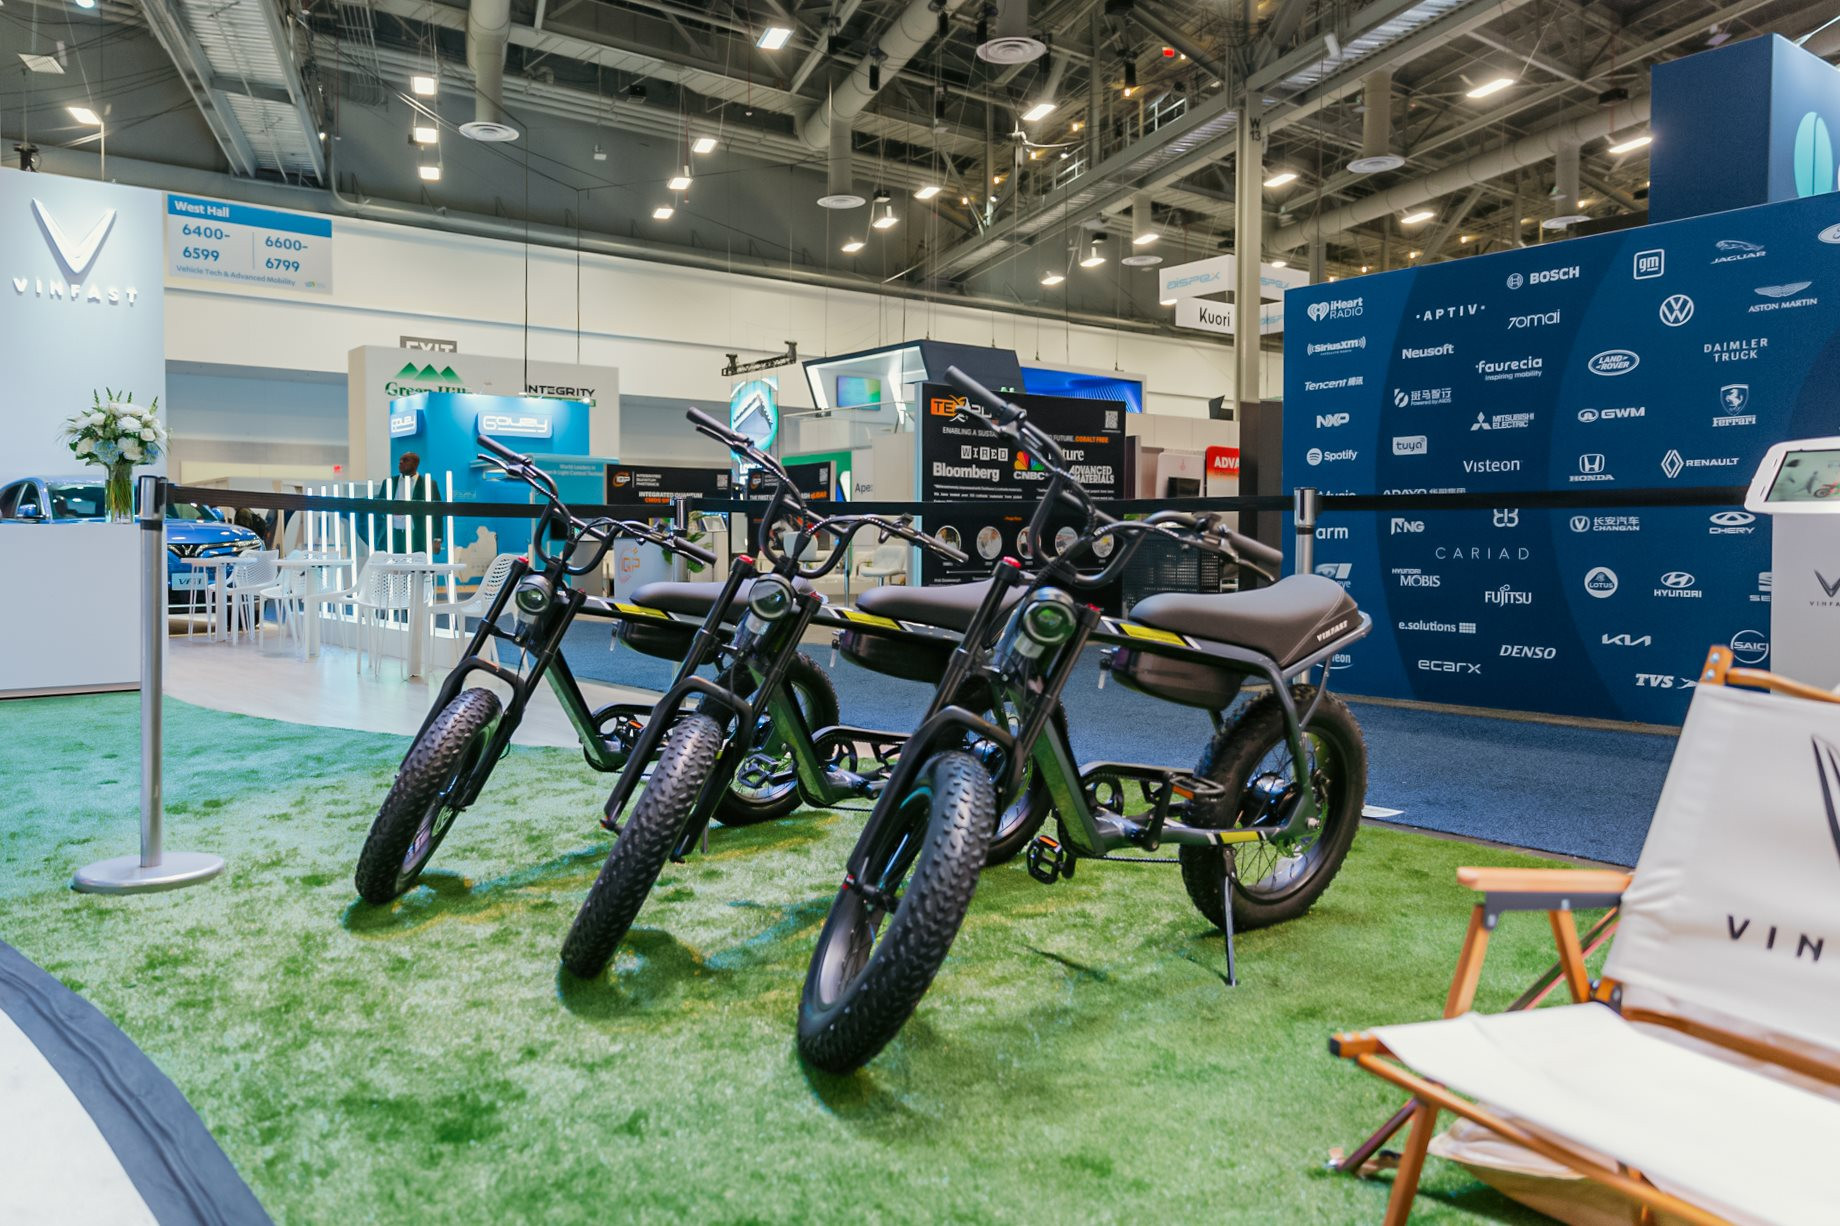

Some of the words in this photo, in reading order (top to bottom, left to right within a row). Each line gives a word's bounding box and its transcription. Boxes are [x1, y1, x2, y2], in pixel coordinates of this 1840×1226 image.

[174, 200, 205, 215] West
[207, 204, 230, 218] Hall
[182, 223, 230, 241] 6400-
[265, 235, 309, 252] 6600-
[183, 246, 219, 262] 6599
[1710, 251, 1767, 265] JAGUAR
[265, 257, 300, 273] 6799
[176, 264, 203, 275] Vehicle
[205, 269, 222, 277] Tech
[230, 272, 266, 283] Advanced
[266, 277, 296, 287] Mobility
[1529, 265, 1581, 285] BOSCH
[12, 277, 138, 306] VINFAST
[1330, 297, 1363, 309] iHeart
[1748, 302, 1779, 313] ASTON
[1780, 298, 1818, 309] MARTIN
[1199, 307, 1231, 327] Kuori
[1330, 306, 1363, 320] RADIO
[1507, 309, 1560, 330] 70mai
[1402, 343, 1454, 360] Neusoft
[1703, 338, 1769, 353] DAIMLER
[1599, 355, 1622, 364] LAND
[1713, 350, 1758, 363] TRUCK
[1478, 356, 1543, 374] faurecia
[1600, 361, 1630, 370] ROVER
[1485, 373, 1513, 381] inspiring
[1514, 370, 1542, 379] mobility
[1305, 379, 1347, 391] Tencent
[1492, 413, 1534, 423] MITSUBISHI
[1601, 407, 1646, 419] GWM
[1316, 413, 1350, 429] NXP
[1492, 421, 1529, 430] ELECTRIC
[1712, 415, 1757, 427] Ferrari
[942, 426, 971, 436] ENABLING
[1395, 438, 1424, 452] tuya
[960, 445, 1009, 461] WIRED
[1048, 449, 1084, 461] ture
[1324, 449, 1358, 463] Spotify
[1463, 459, 1521, 473] Visteon
[1686, 457, 1740, 467] RENAULT
[932, 462, 1000, 482] Bloomberg
[1013, 471, 1045, 480] CNBC
[1069, 465, 1112, 475] ADVANCED
[1569, 474, 1615, 482] HONDA
[638, 491, 675, 499] INTEGRATED
[854, 483, 873, 493] Ape
[1315, 526, 1349, 539] arm
[1435, 547, 1530, 560] CARIAD
[1400, 574, 1441, 587] MOBIS
[1484, 584, 1532, 607] FUJITSU
[1653, 589, 1702, 598] HYUNDAI
[1749, 594, 1772, 602] SE
[1317, 620, 1348, 642] VINFAST
[1398, 620, 1456, 633] e.solutions
[1499, 644, 1557, 659] DENSO
[1734, 641, 1766, 651] SAIC
[1418, 659, 1481, 674] ecarx
[1635, 673, 1675, 688] TVS
